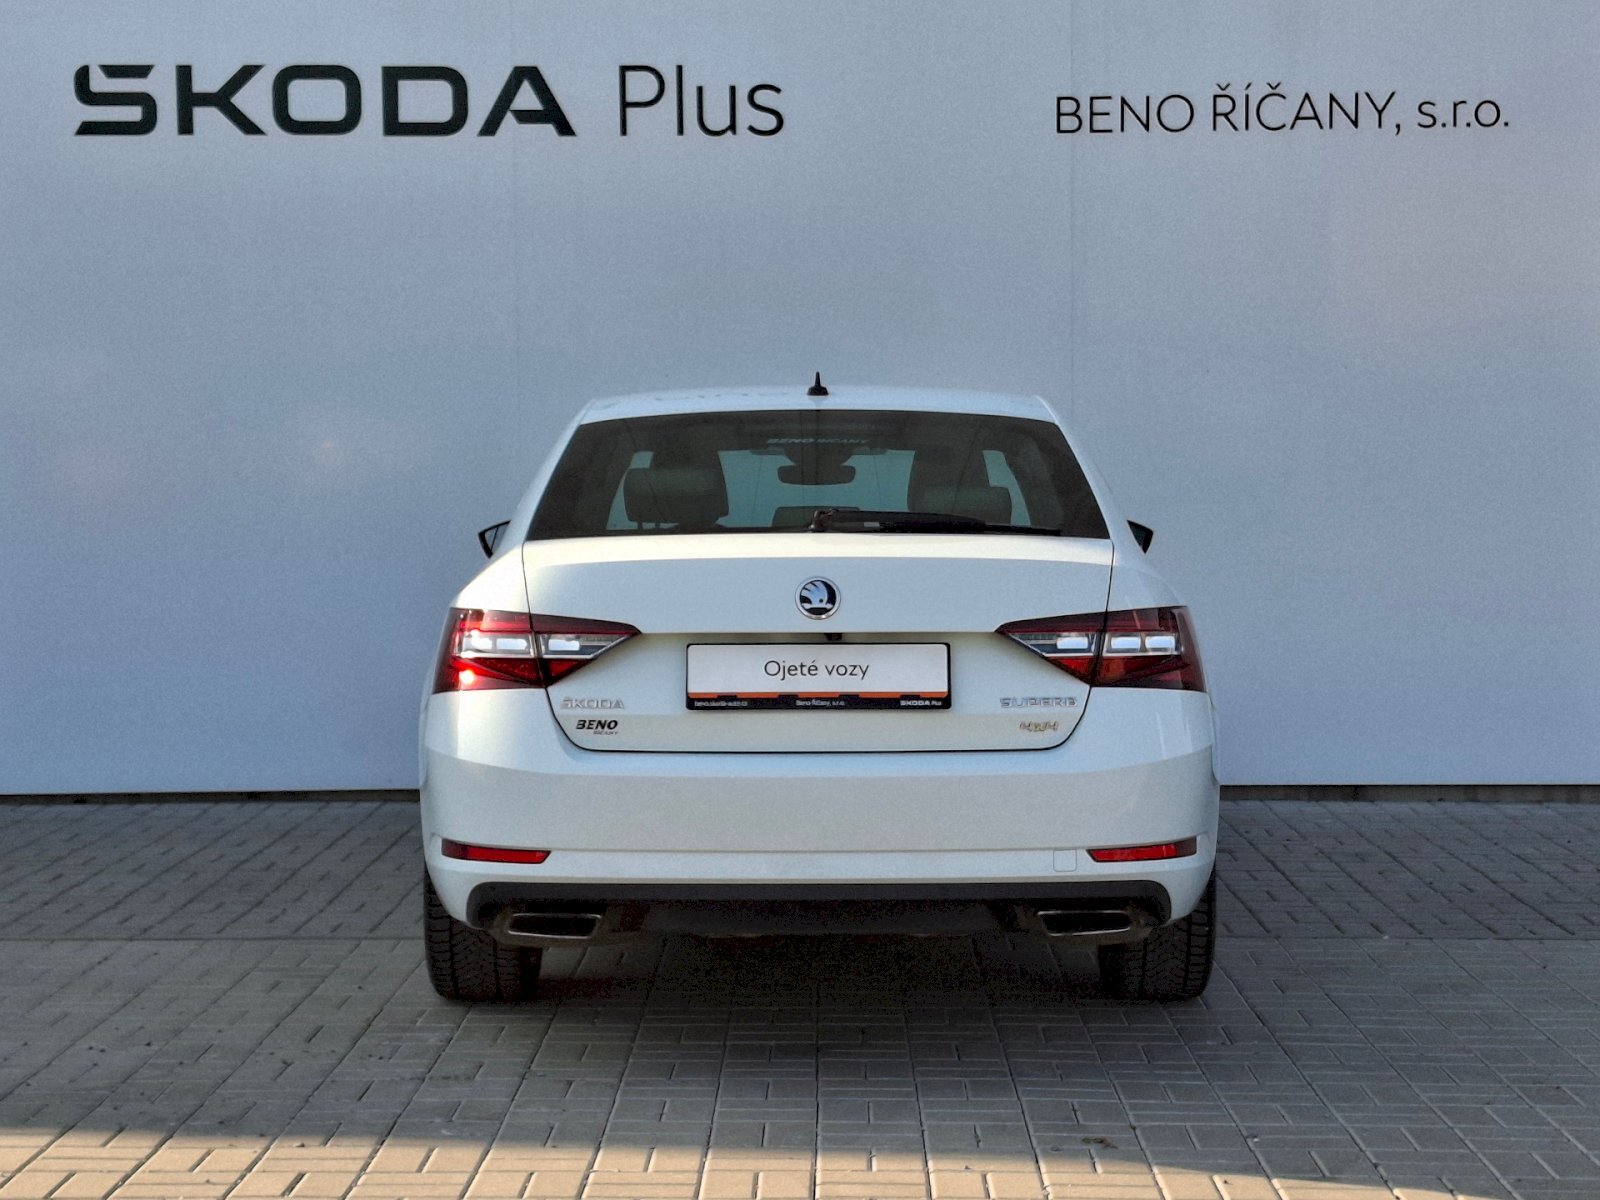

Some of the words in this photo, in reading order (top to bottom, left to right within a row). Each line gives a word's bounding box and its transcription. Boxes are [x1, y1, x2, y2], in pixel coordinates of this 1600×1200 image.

[619, 65, 784, 137] Plus
[1056, 94, 1194, 134] BENO
[1213, 82, 1400, 135] ŘÍČANY,
[1418, 99, 1508, 128] s.r.o.
[764, 660, 818, 681] Ojeté
[825, 664, 869, 681] vozy
[1000, 697, 1077, 708] SUPERB
[576, 719, 618, 730] BENO
